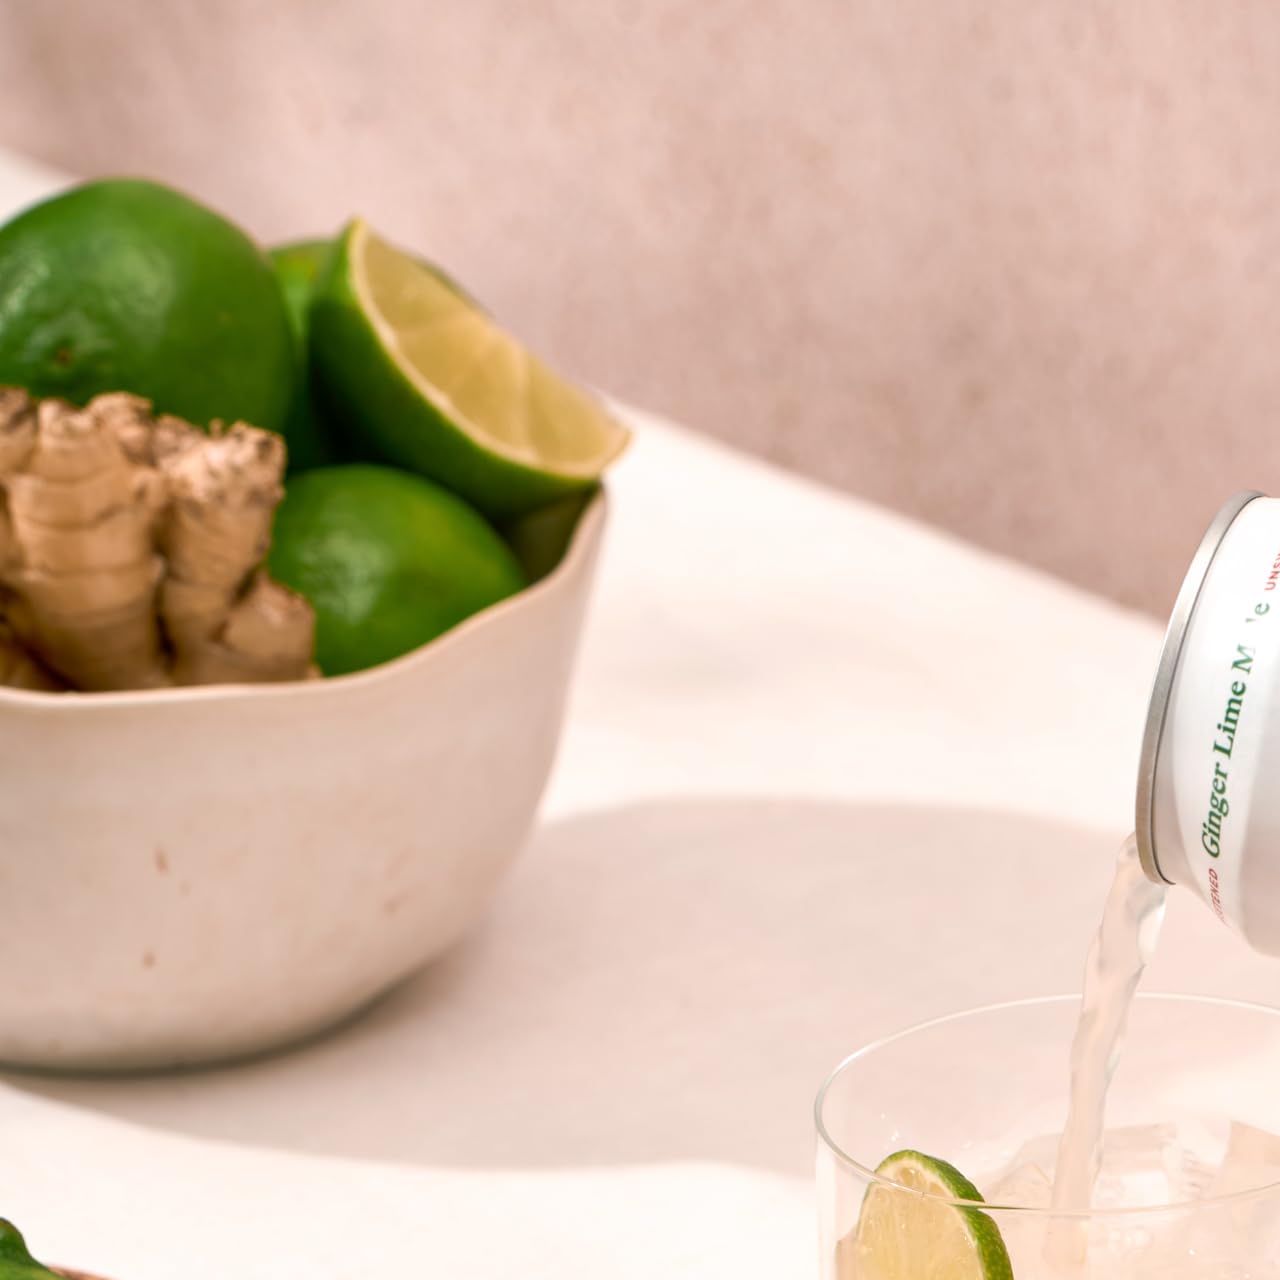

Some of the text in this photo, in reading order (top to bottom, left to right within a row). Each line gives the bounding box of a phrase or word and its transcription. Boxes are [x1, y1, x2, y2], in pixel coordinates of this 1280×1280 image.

[1202, 602, 1270, 859] Ginger Lime Me
